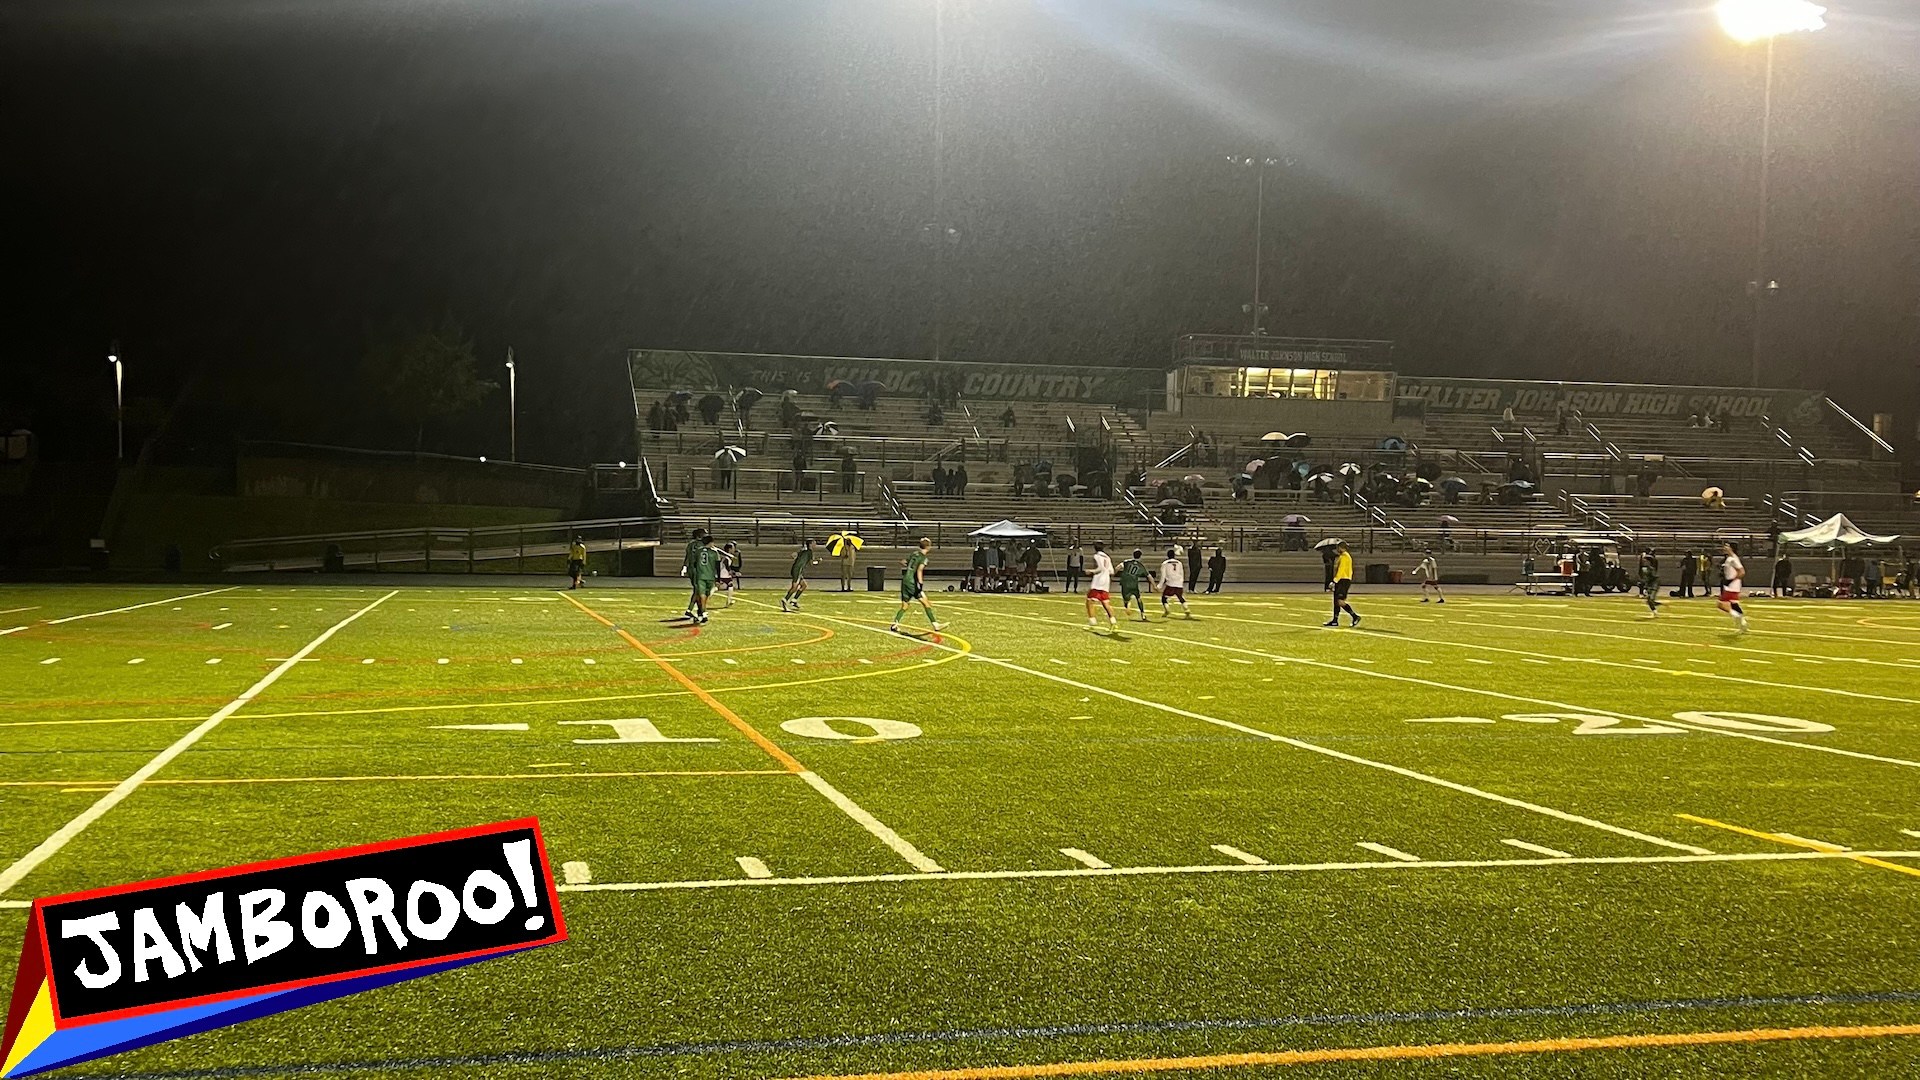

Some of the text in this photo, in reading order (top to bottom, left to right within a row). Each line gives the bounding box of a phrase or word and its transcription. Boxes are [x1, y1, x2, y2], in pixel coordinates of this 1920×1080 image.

[1239, 349, 1270, 360] WALTER
[963, 372, 1105, 398] COUNTRY
[1399, 385, 1503, 411] WALTER
[1623, 392, 1685, 415] HIGH
[1689, 395, 1774, 417] SCHOOL
[1127, 564, 1140, 577] 10
[557, 716, 923, 744] 10
[1500, 711, 1837, 735] 20
